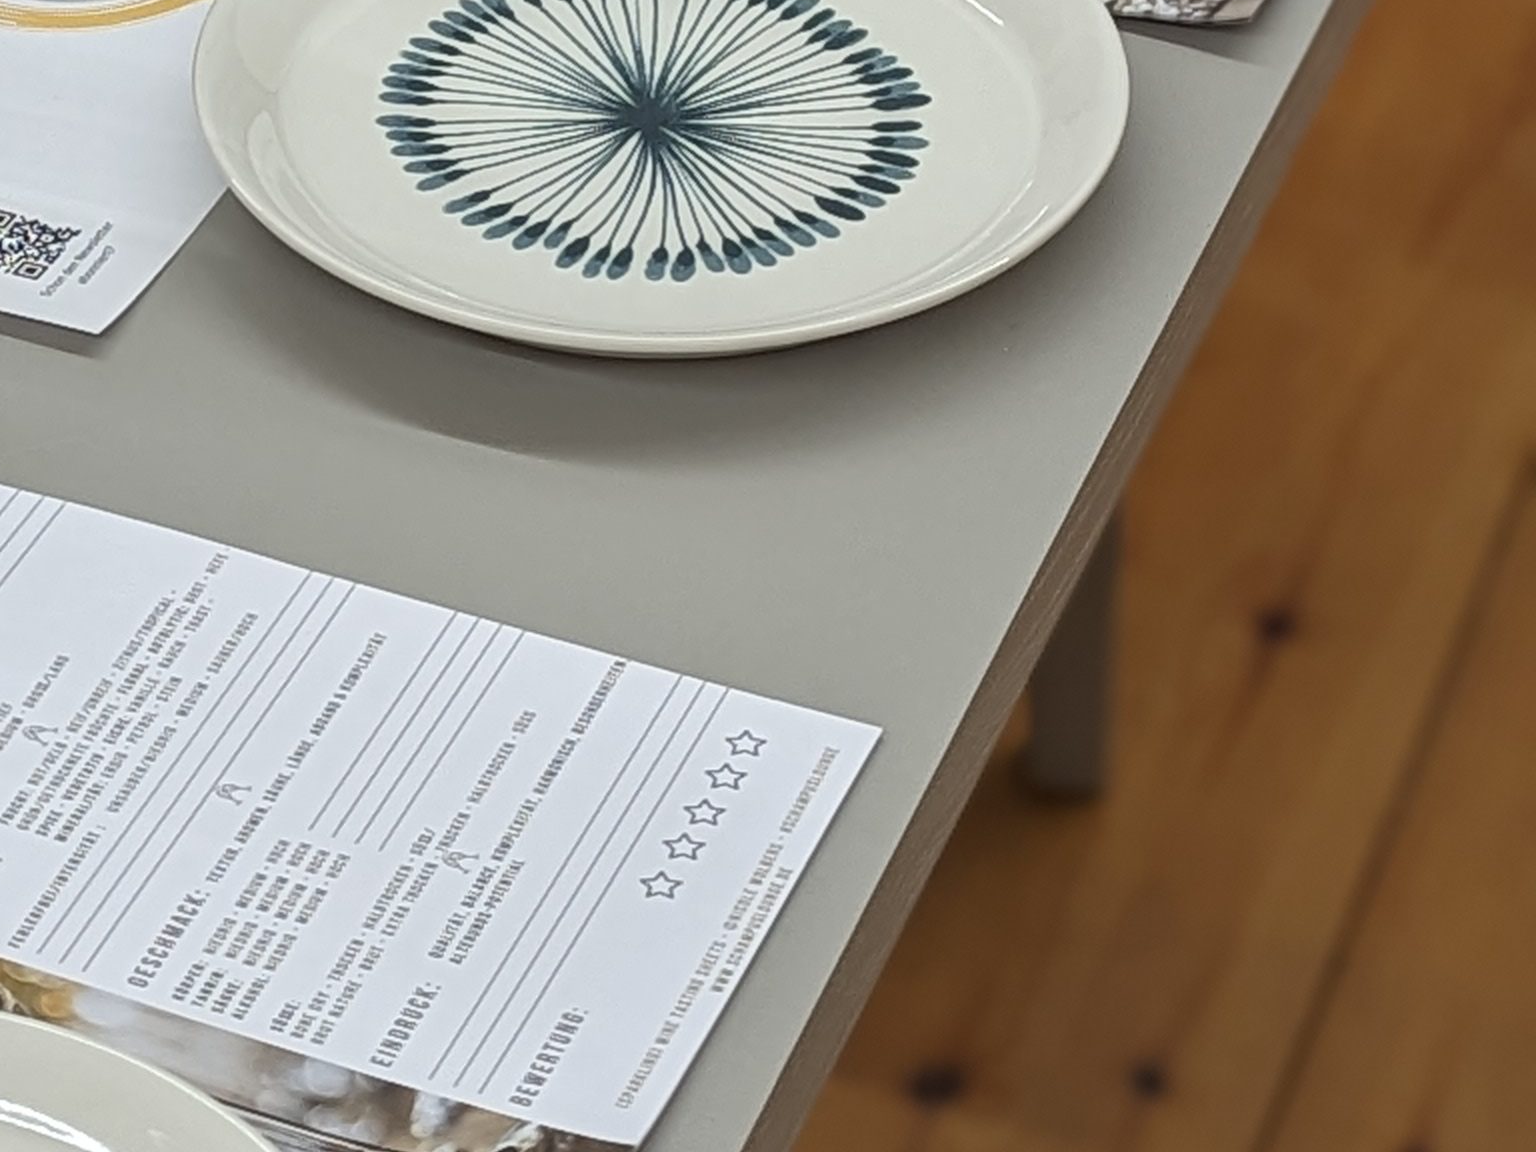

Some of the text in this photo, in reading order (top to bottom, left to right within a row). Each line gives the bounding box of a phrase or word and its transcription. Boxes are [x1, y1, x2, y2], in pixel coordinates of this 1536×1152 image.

[126, 889, 211, 988] GESCHMACK:
[368, 981, 442, 1068] EINDRUCK:
[508, 1006, 589, 1107] BEWERTUNG:
